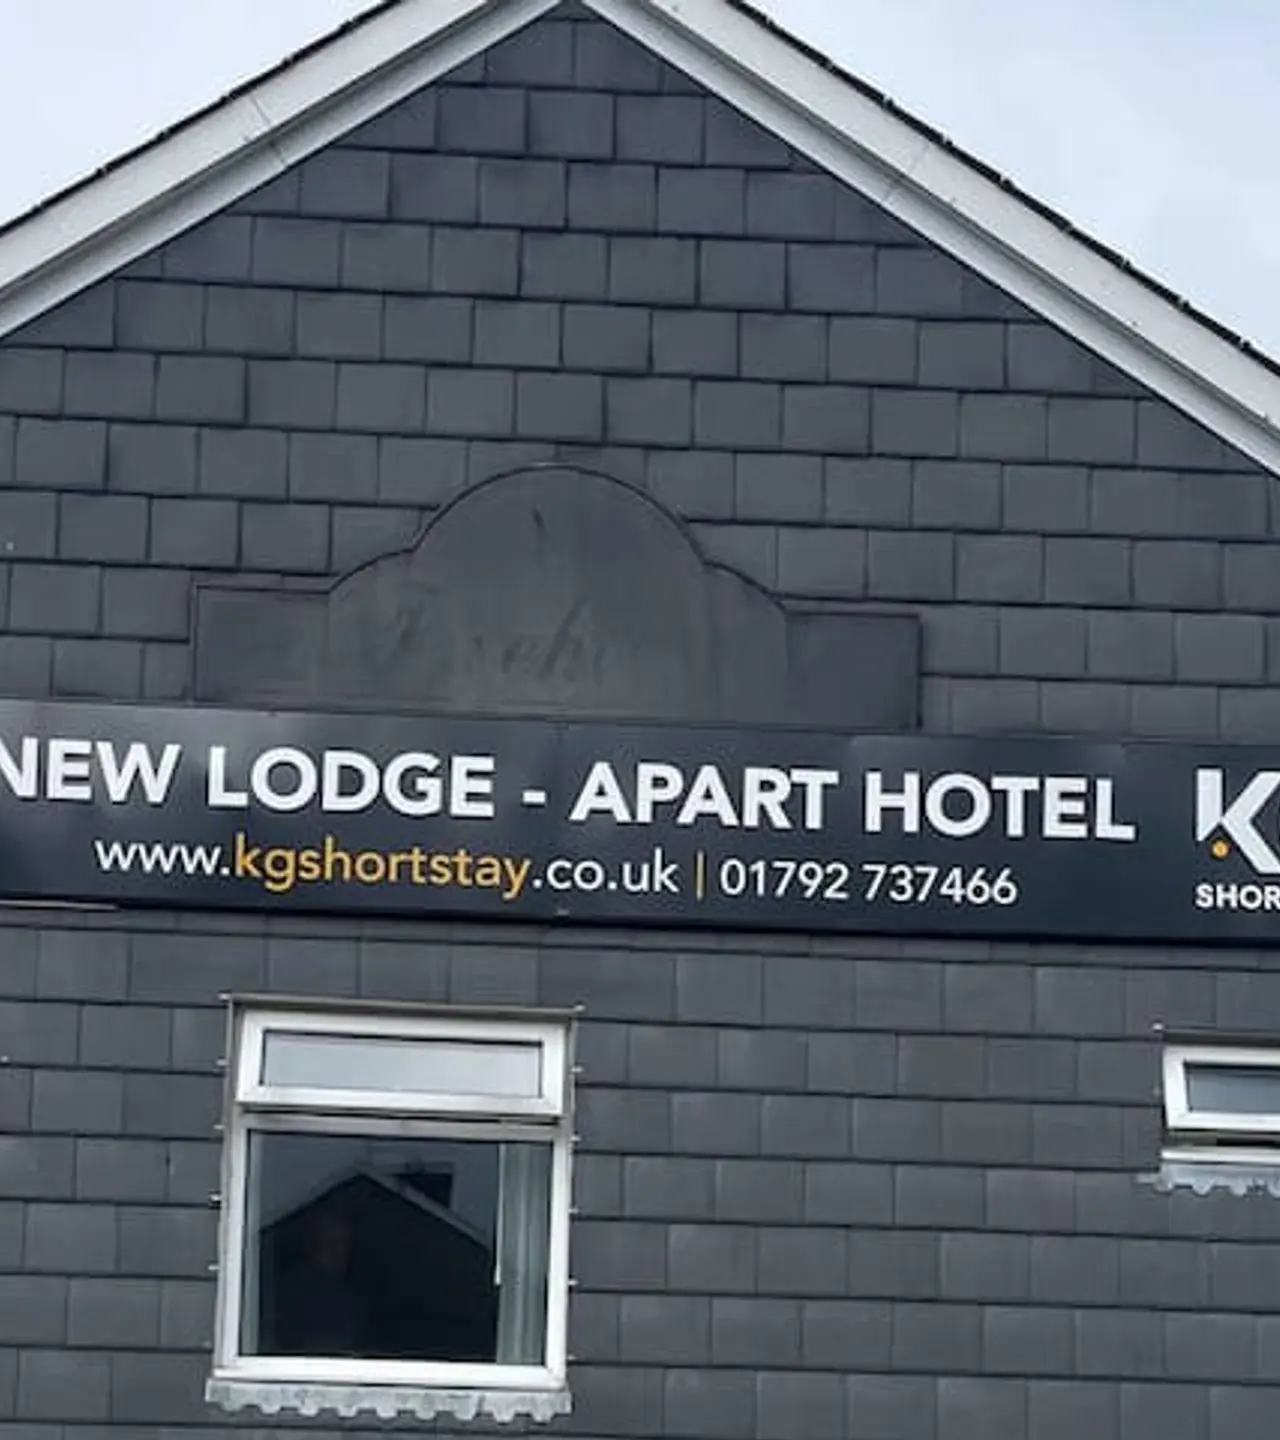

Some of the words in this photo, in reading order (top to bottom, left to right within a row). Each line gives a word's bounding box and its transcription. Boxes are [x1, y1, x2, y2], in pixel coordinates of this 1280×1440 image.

[206, 744, 495, 817] LODGE
[569, 761, 839, 831] APART
[864, 771, 1136, 841] HOTEL
[95, 833, 680, 899] www.kgshortstay.co.uk
[720, 858, 849, 900] 01792
[862, 863, 1018, 905] 737466
